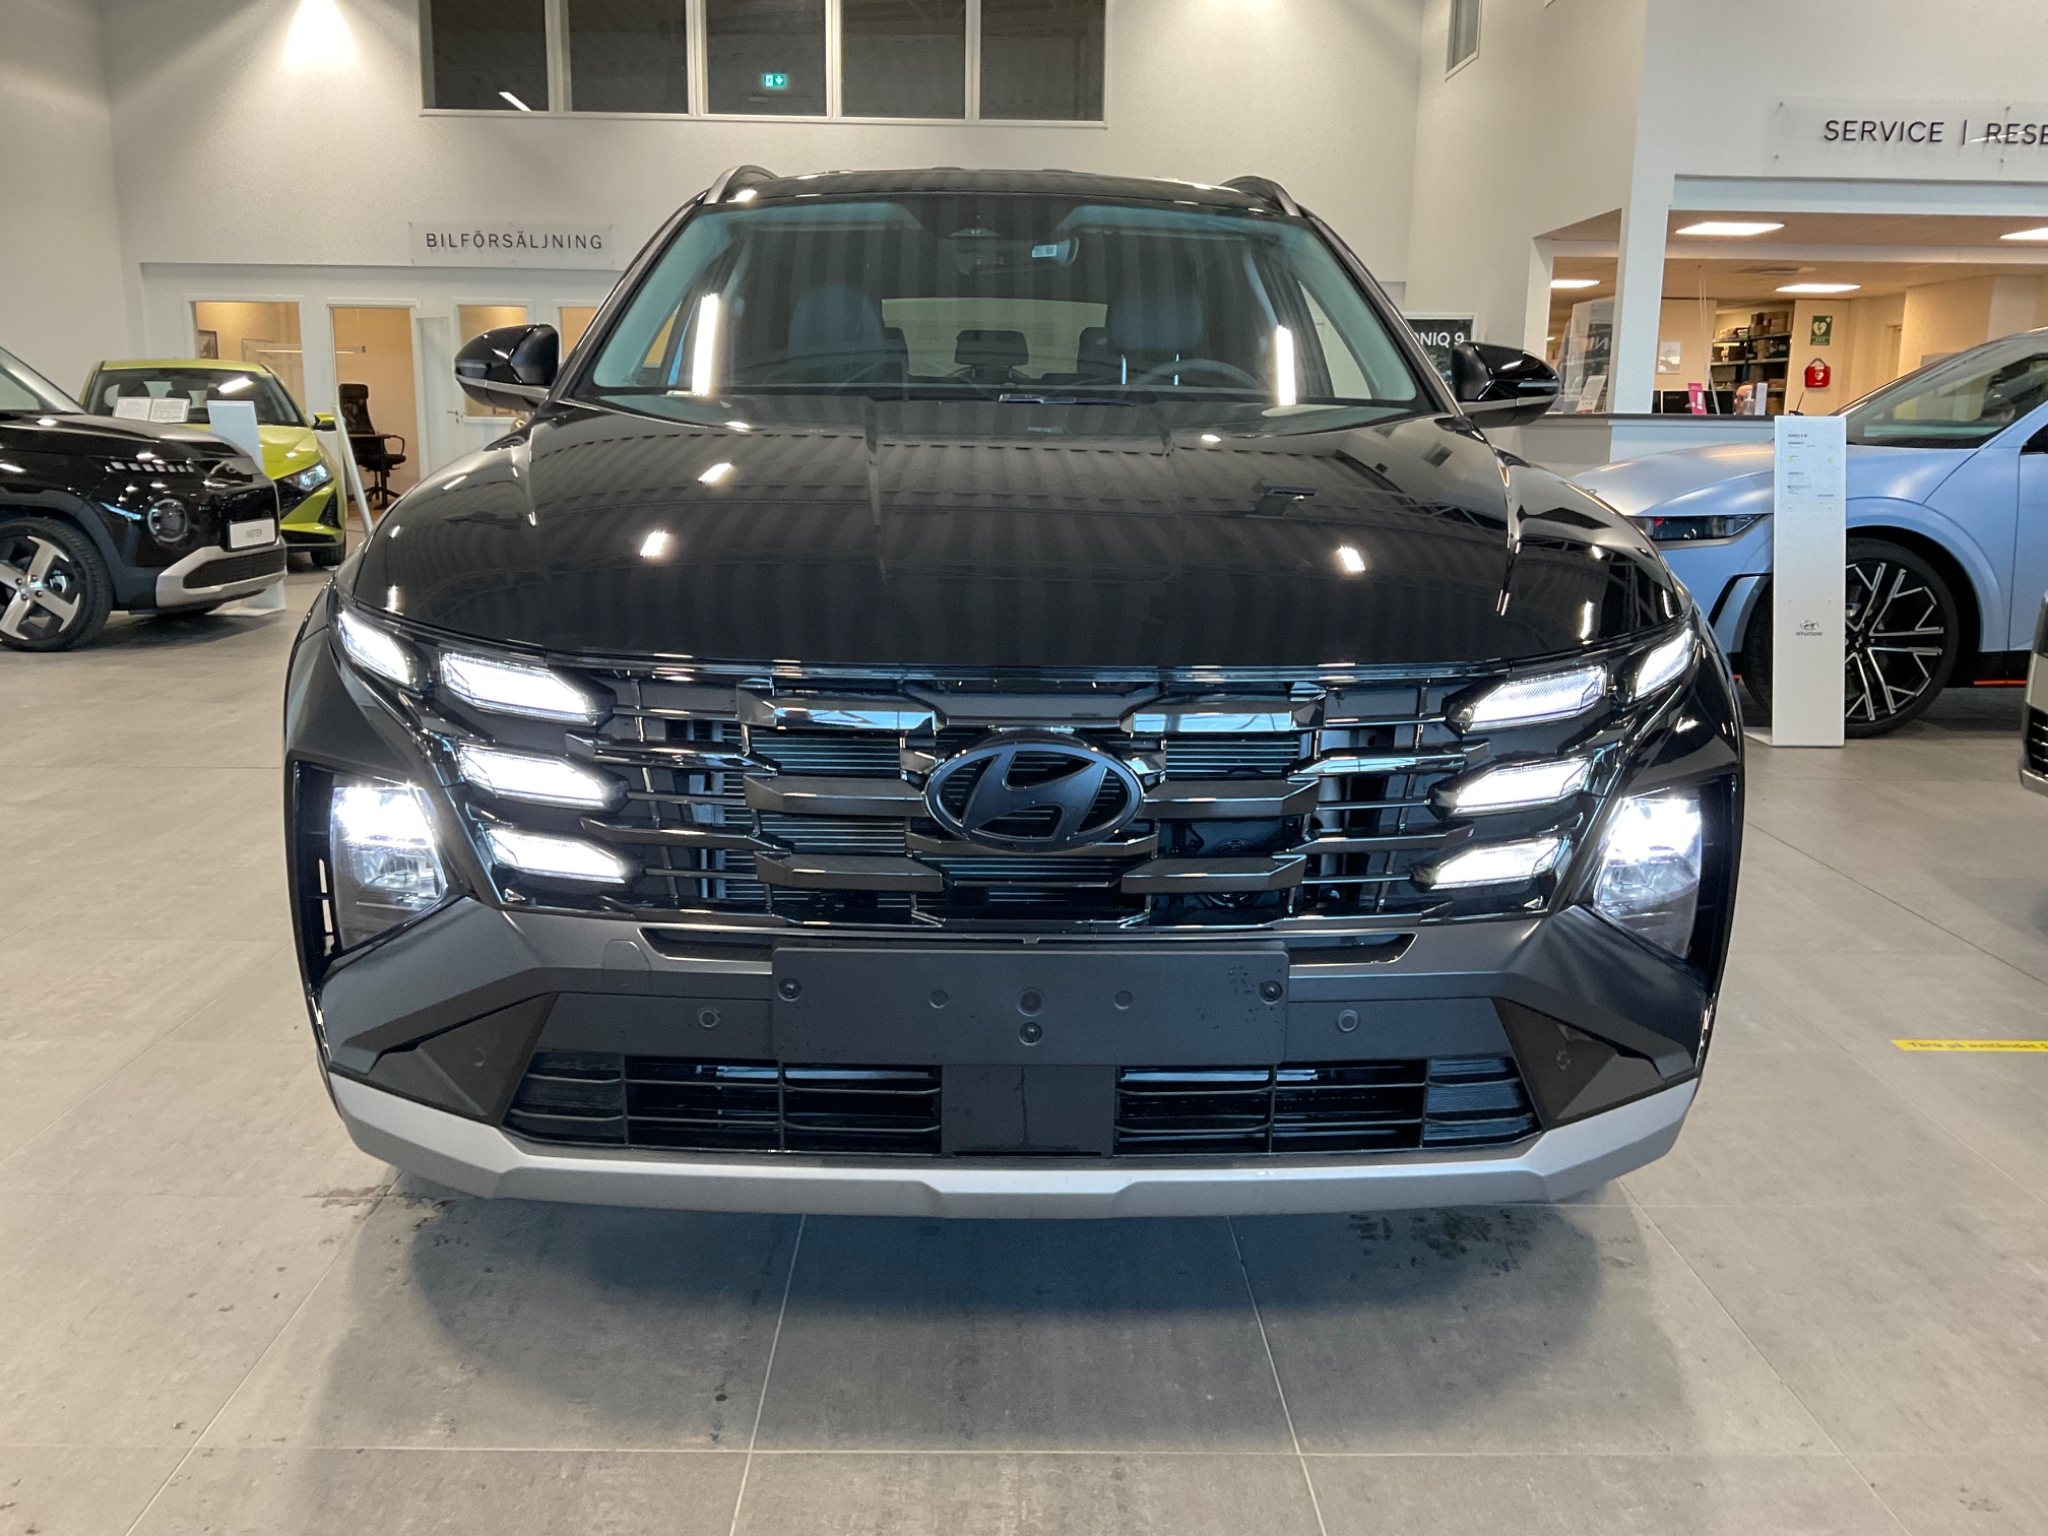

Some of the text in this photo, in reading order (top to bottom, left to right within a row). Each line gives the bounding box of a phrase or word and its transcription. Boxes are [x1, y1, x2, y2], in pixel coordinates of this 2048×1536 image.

[1823, 120, 1945, 143] SERVICE
[426, 230, 603, 250] BILFÖRSÄLJNING
[1414, 331, 1465, 349] NIQ 9
